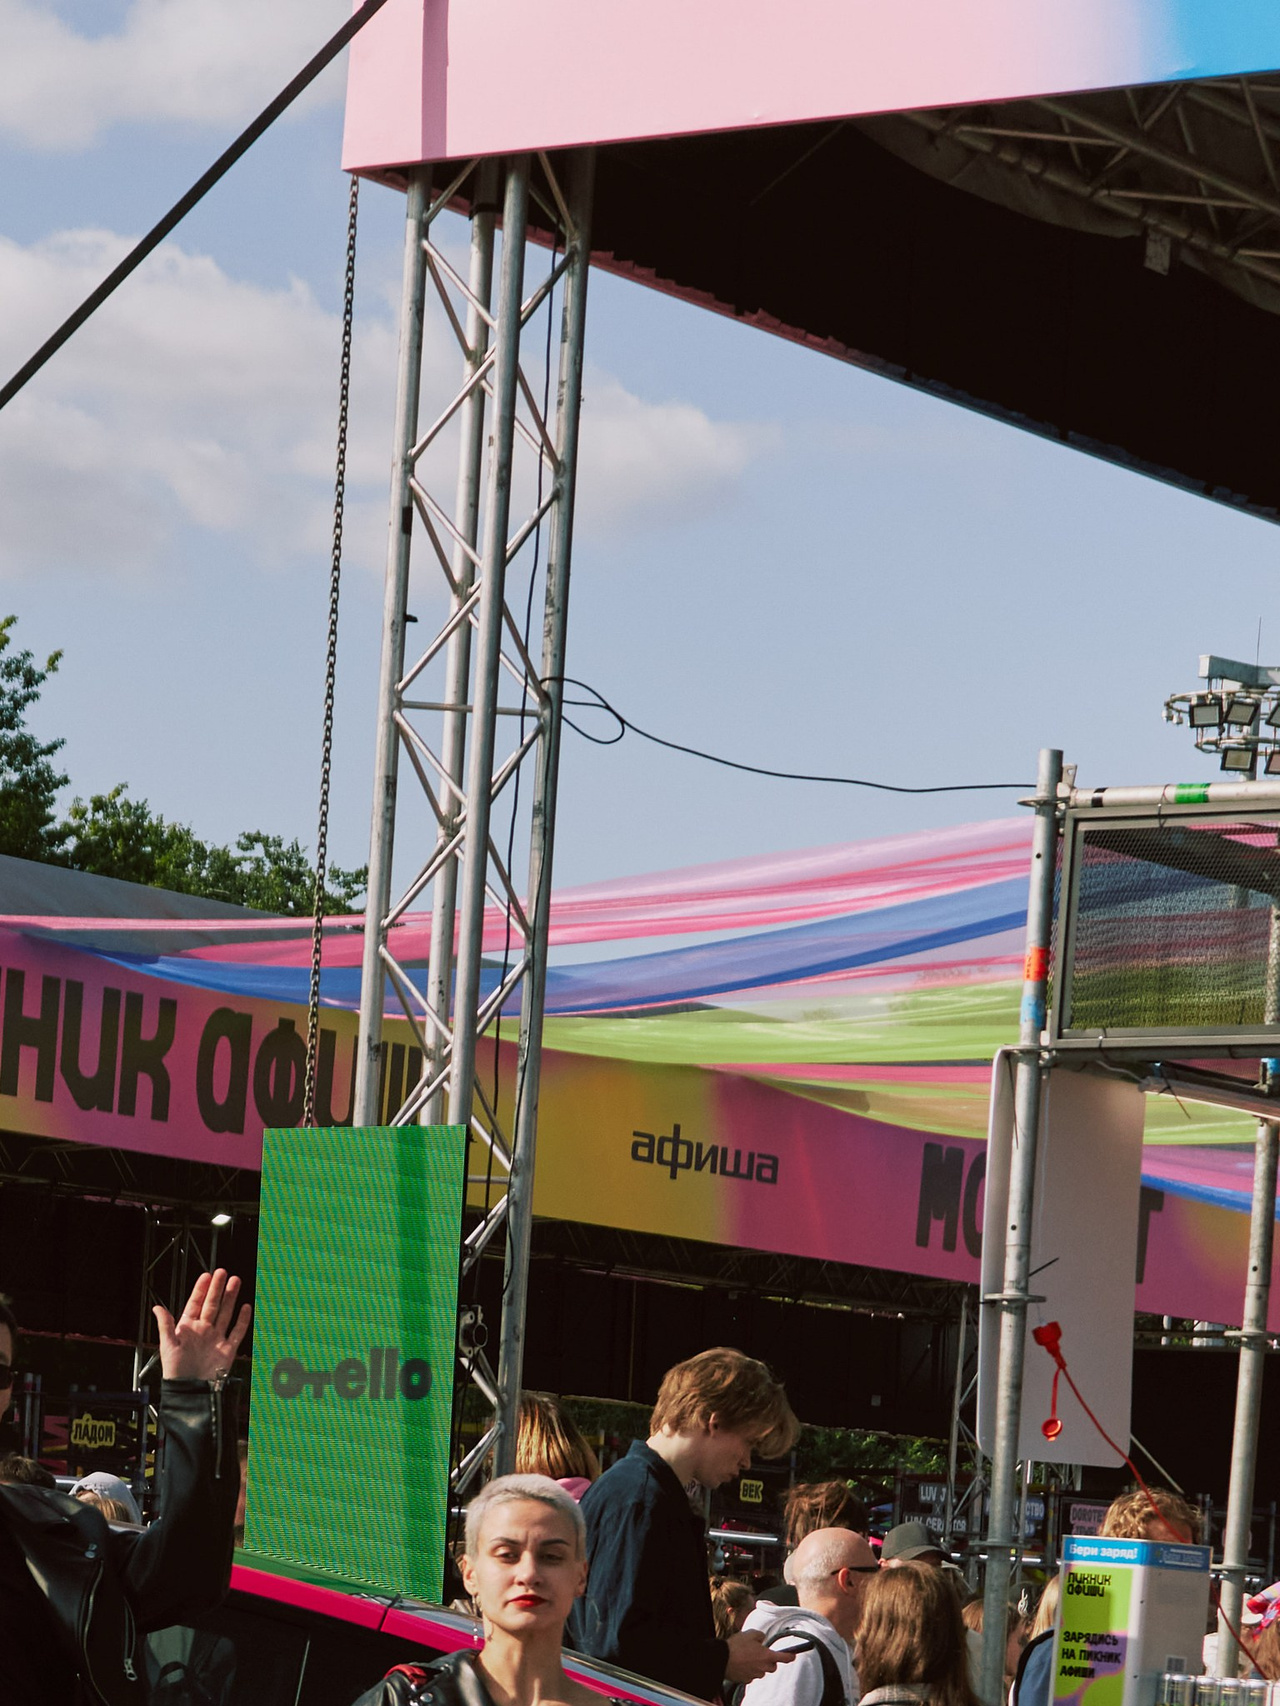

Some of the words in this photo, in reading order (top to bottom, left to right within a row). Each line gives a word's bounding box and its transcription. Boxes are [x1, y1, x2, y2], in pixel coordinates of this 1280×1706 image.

[631, 1123, 779, 1184] афиша
[1069, 1543, 1098, 1557] Бери
[1100, 1546, 1138, 1560] заряд!
[1068, 1572, 1111, 1586] ПИКНИК
[1062, 1630, 1119, 1646] ЗАРЯДИСЬ
[1061, 1647, 1076, 1660] НА
[1078, 1649, 1122, 1664] ПИКНИК
[1059, 1665, 1095, 1679] АФИШИ
